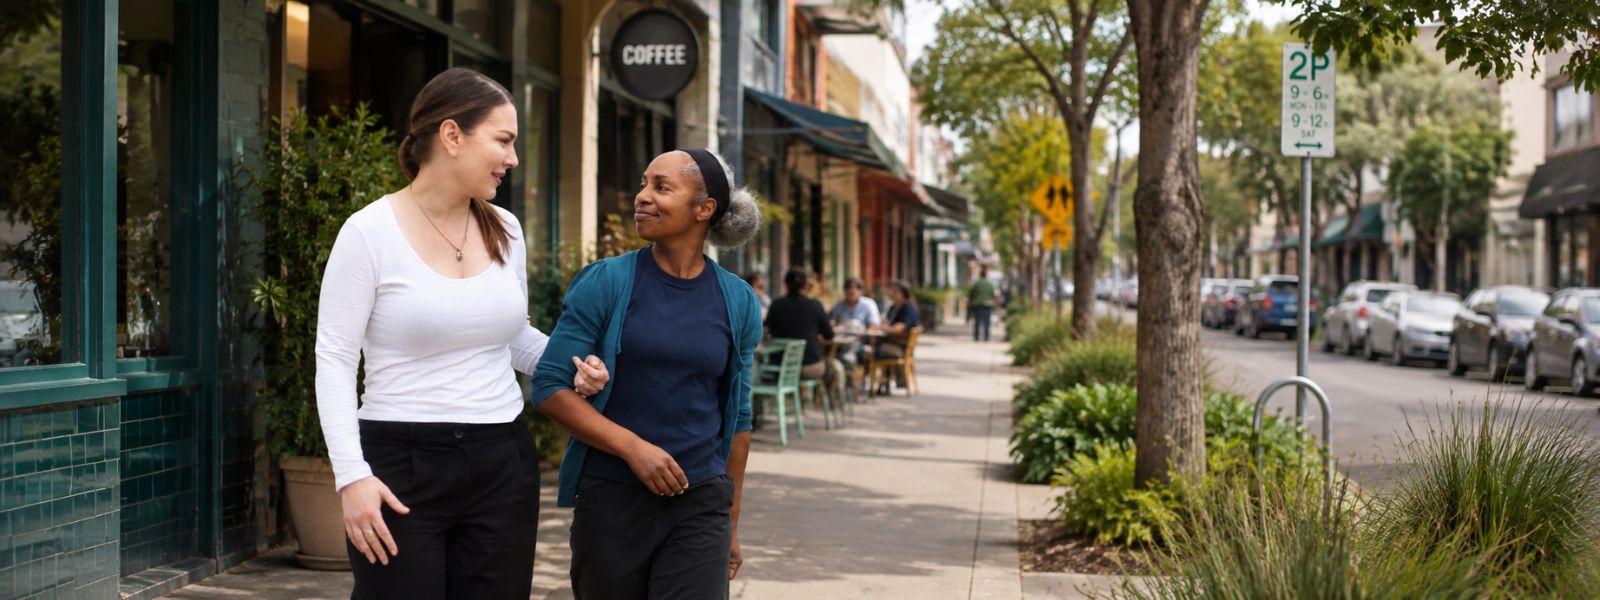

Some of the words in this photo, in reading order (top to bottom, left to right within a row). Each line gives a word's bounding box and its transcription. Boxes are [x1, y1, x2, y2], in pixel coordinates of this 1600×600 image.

[622, 44, 687, 65] COFFEE
[1289, 50, 1330, 80] 2P
[1290, 84, 1300, 99] 9
[1290, 101, 1307, 110] MON
[1314, 101, 1327, 110] FRI
[1301, 130, 1315, 138] SAT
